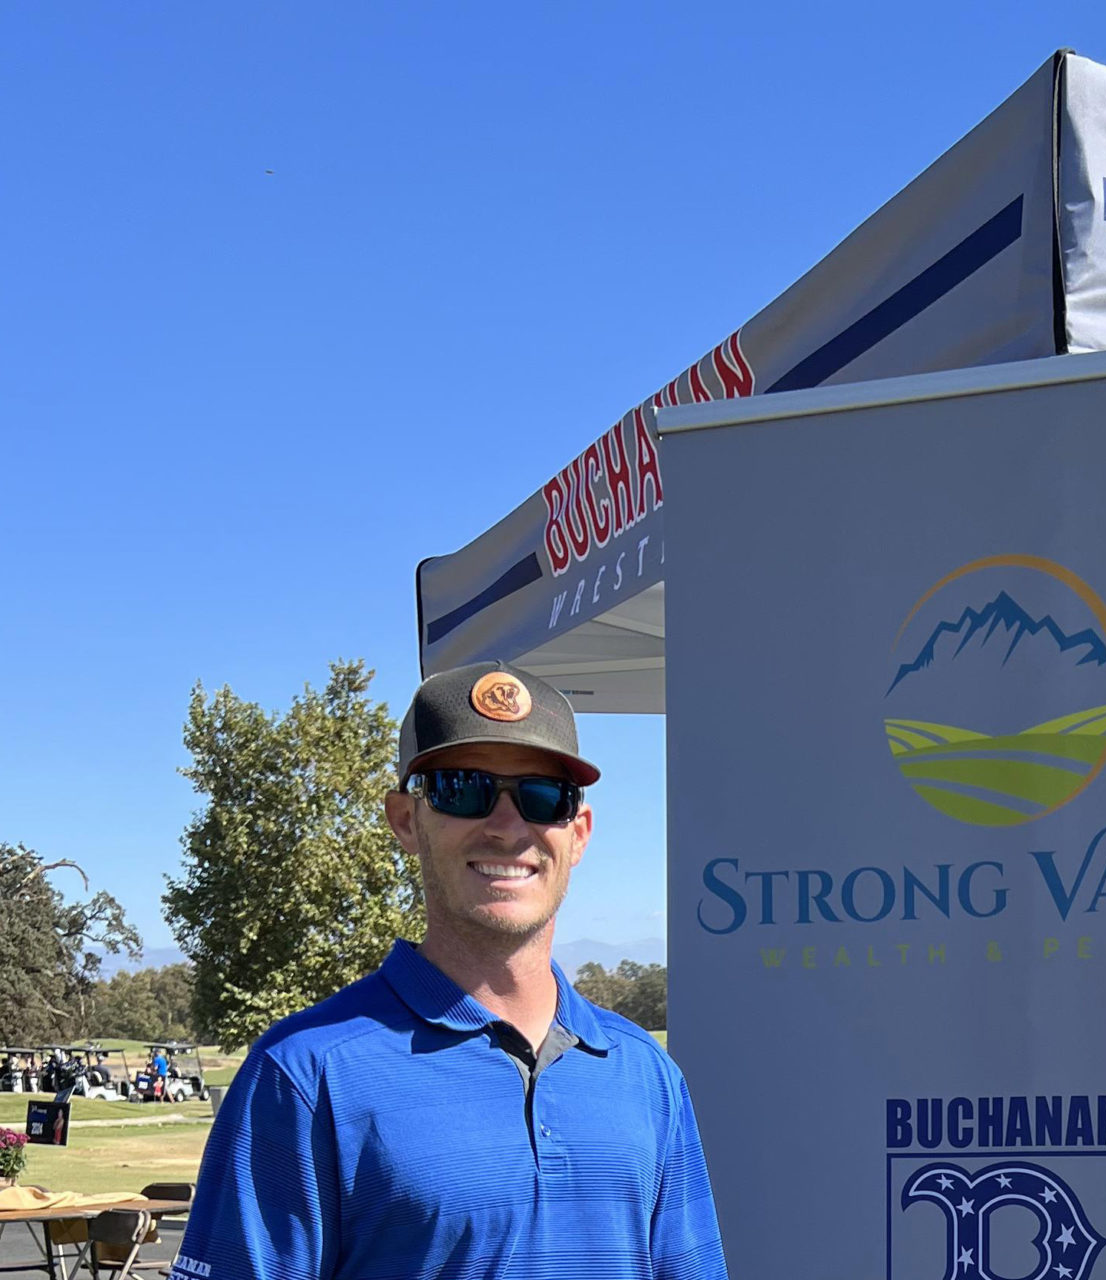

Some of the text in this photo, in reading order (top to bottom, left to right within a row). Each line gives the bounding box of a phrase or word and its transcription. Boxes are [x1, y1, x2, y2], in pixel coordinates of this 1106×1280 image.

[541, 327, 756, 577] BUCHAN
[548, 535, 664, 629] WREST
[697, 857, 1011, 936] STRONG
[760, 944, 948, 969] WEALTH
[986, 942, 1002, 963] &
